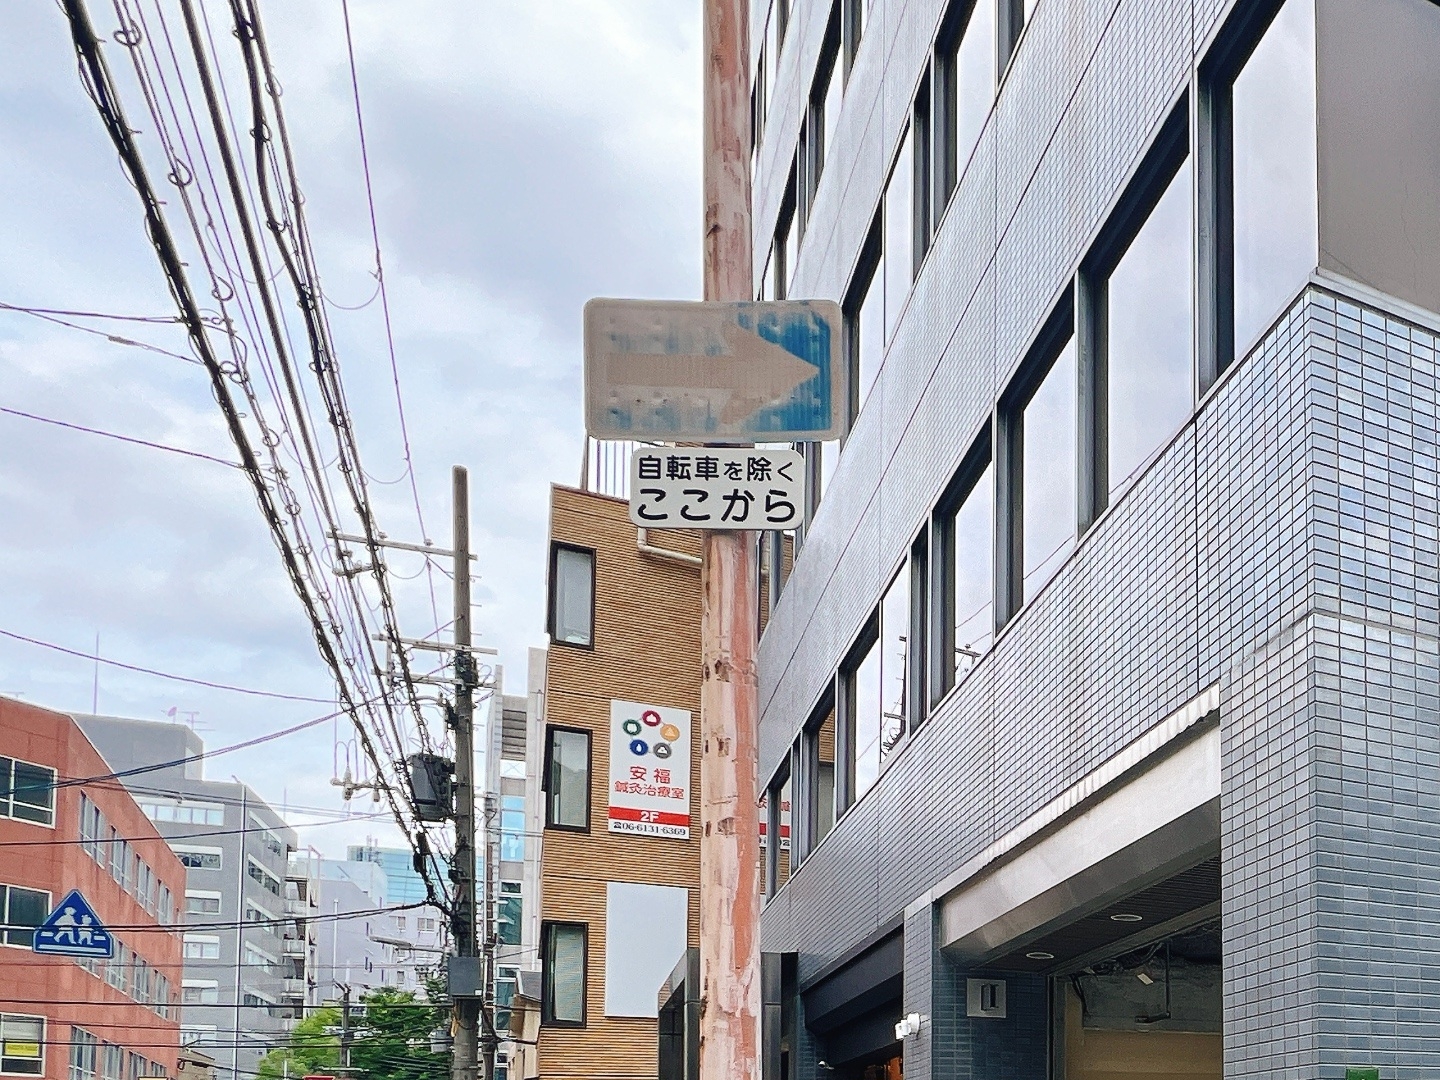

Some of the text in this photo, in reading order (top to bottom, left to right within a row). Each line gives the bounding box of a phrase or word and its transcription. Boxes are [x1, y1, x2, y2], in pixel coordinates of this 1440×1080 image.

[637, 454, 794, 483] 自転車を除く
[637, 488, 796, 523] ここから
[630, 766, 671, 784] 安福
[640, 810, 660, 823] 2F
